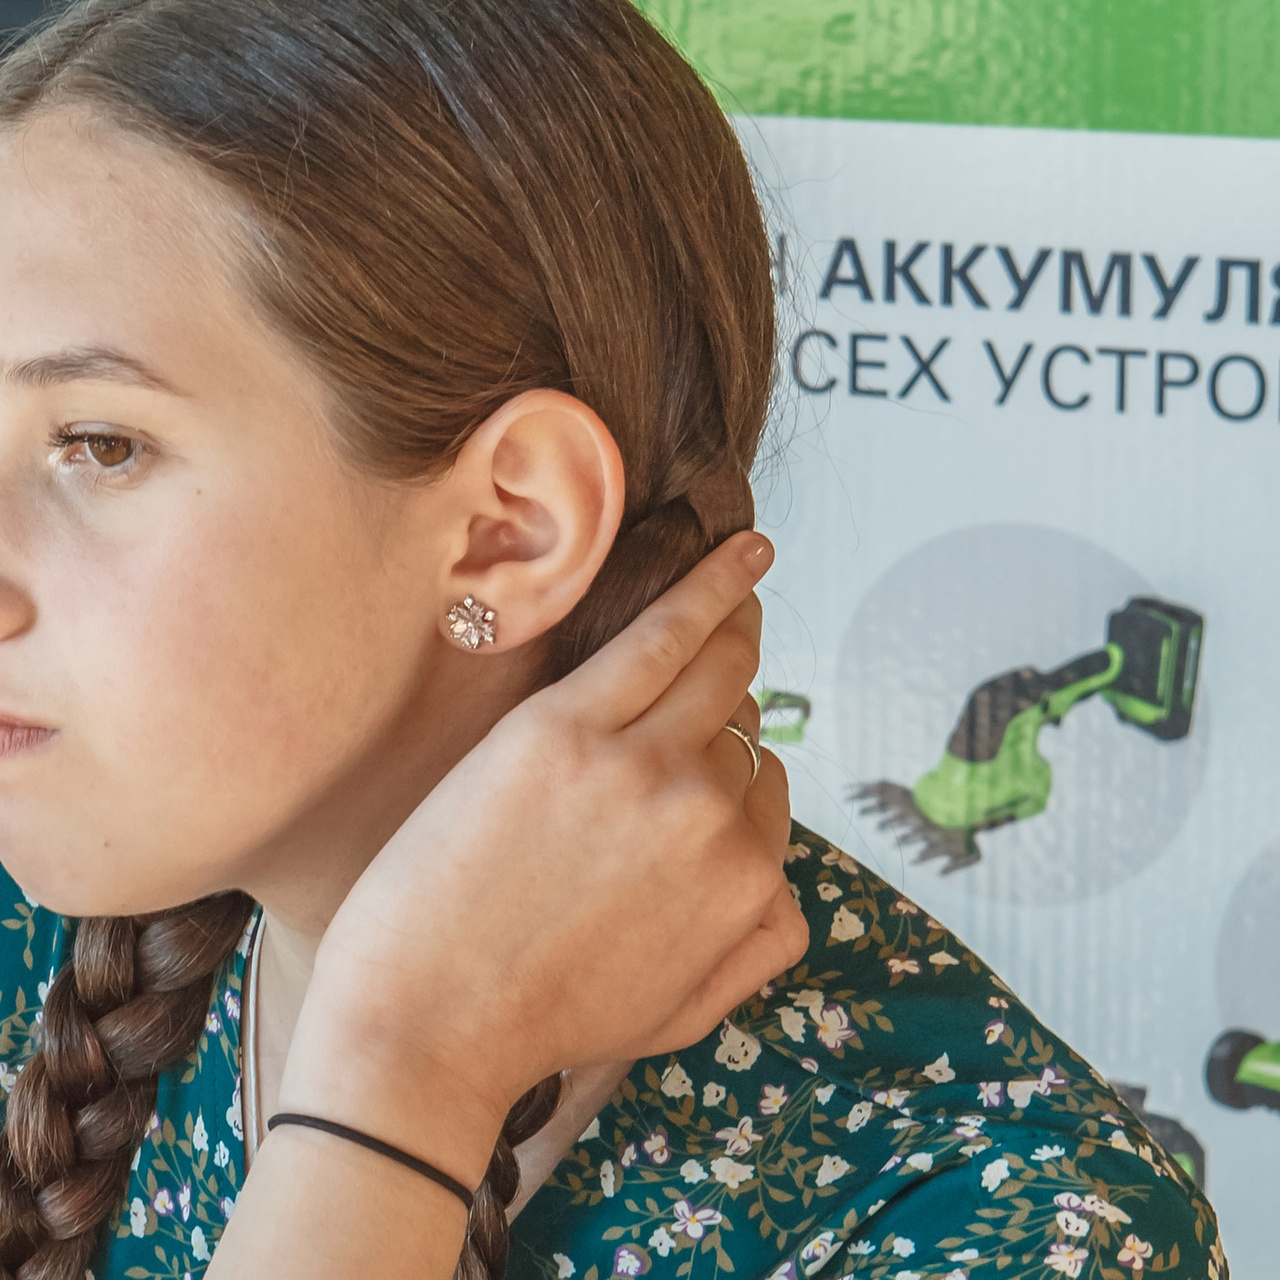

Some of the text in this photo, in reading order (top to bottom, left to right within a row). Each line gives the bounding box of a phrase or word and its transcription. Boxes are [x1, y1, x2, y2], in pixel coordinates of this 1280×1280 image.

[818, 236, 1280, 326] АККУМУЛ
[790, 328, 1280, 424] СЕХ УСТРО
